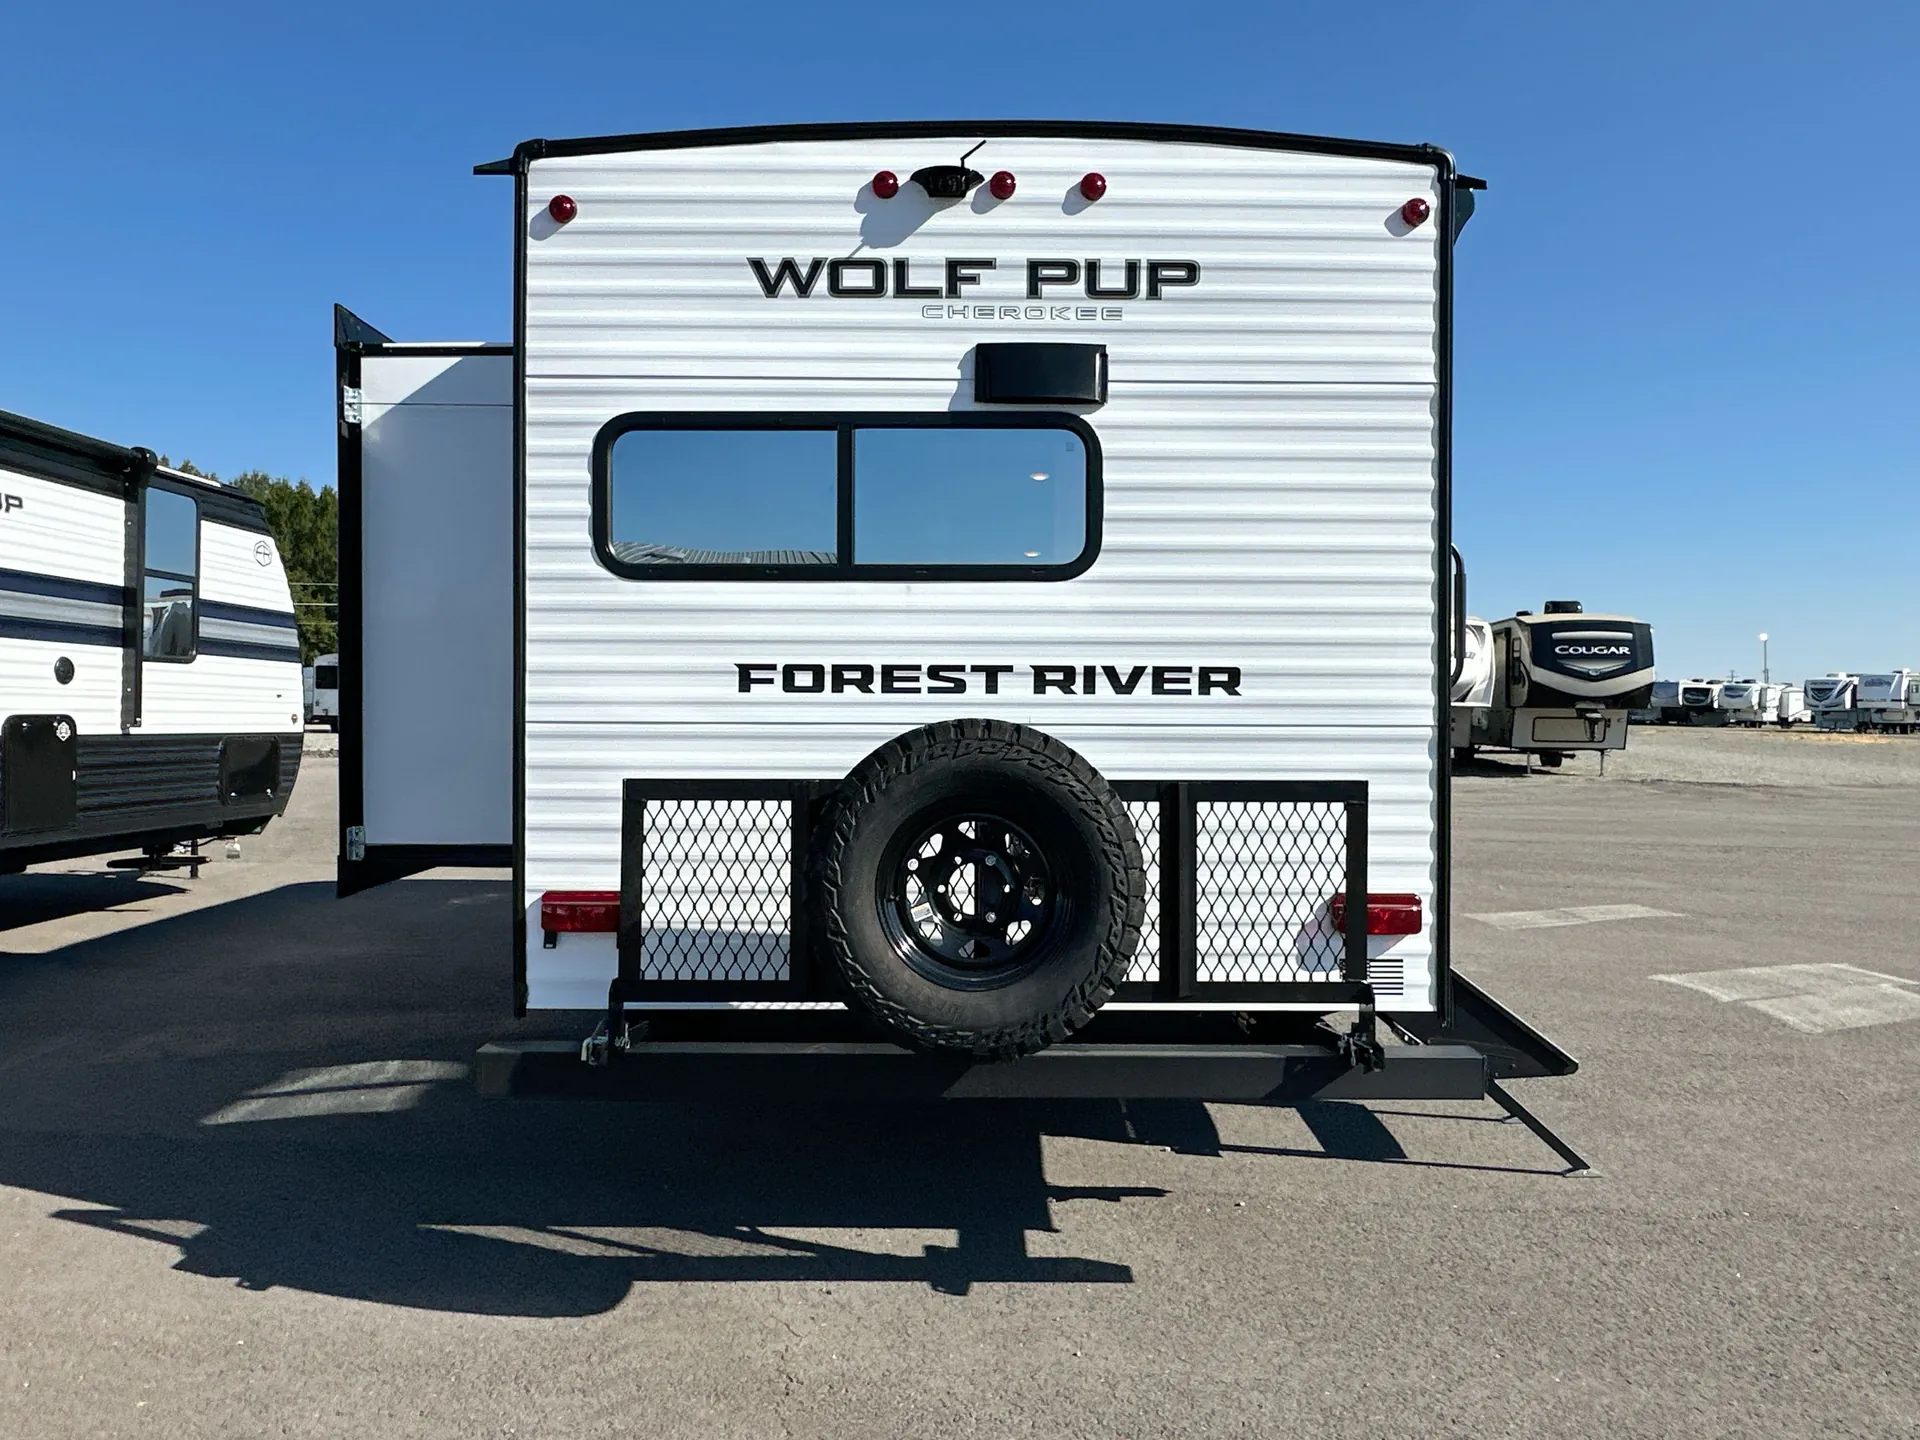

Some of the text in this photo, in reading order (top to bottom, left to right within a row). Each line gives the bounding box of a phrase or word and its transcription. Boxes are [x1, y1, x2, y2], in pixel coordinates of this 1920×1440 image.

[746, 257, 1201, 300] WOLF PUP
[921, 304, 1123, 321] CHEROKEE
[0, 492, 23, 513] P
[1554, 645, 1631, 655] COUGAR
[734, 663, 1242, 697] FOREST RIVER
